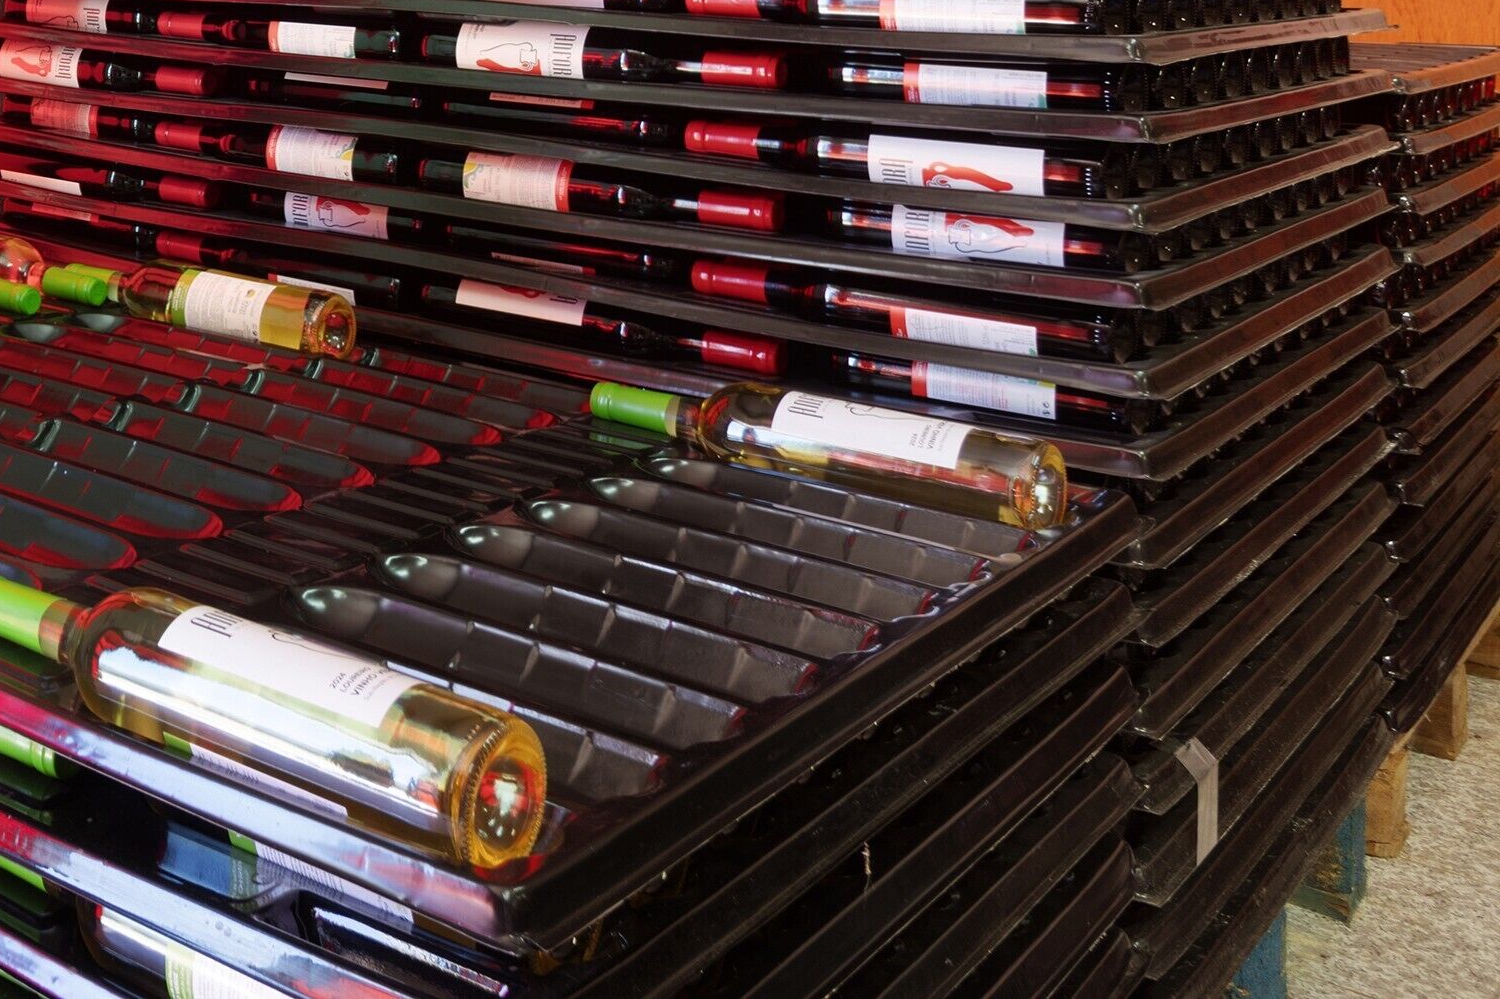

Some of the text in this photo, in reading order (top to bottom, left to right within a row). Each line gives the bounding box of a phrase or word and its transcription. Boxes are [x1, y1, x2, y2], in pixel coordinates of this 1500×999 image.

[55, 46, 76, 79] NFORA
[550, 33, 577, 76] ANFOR
[352, 673, 378, 695] VINHO
